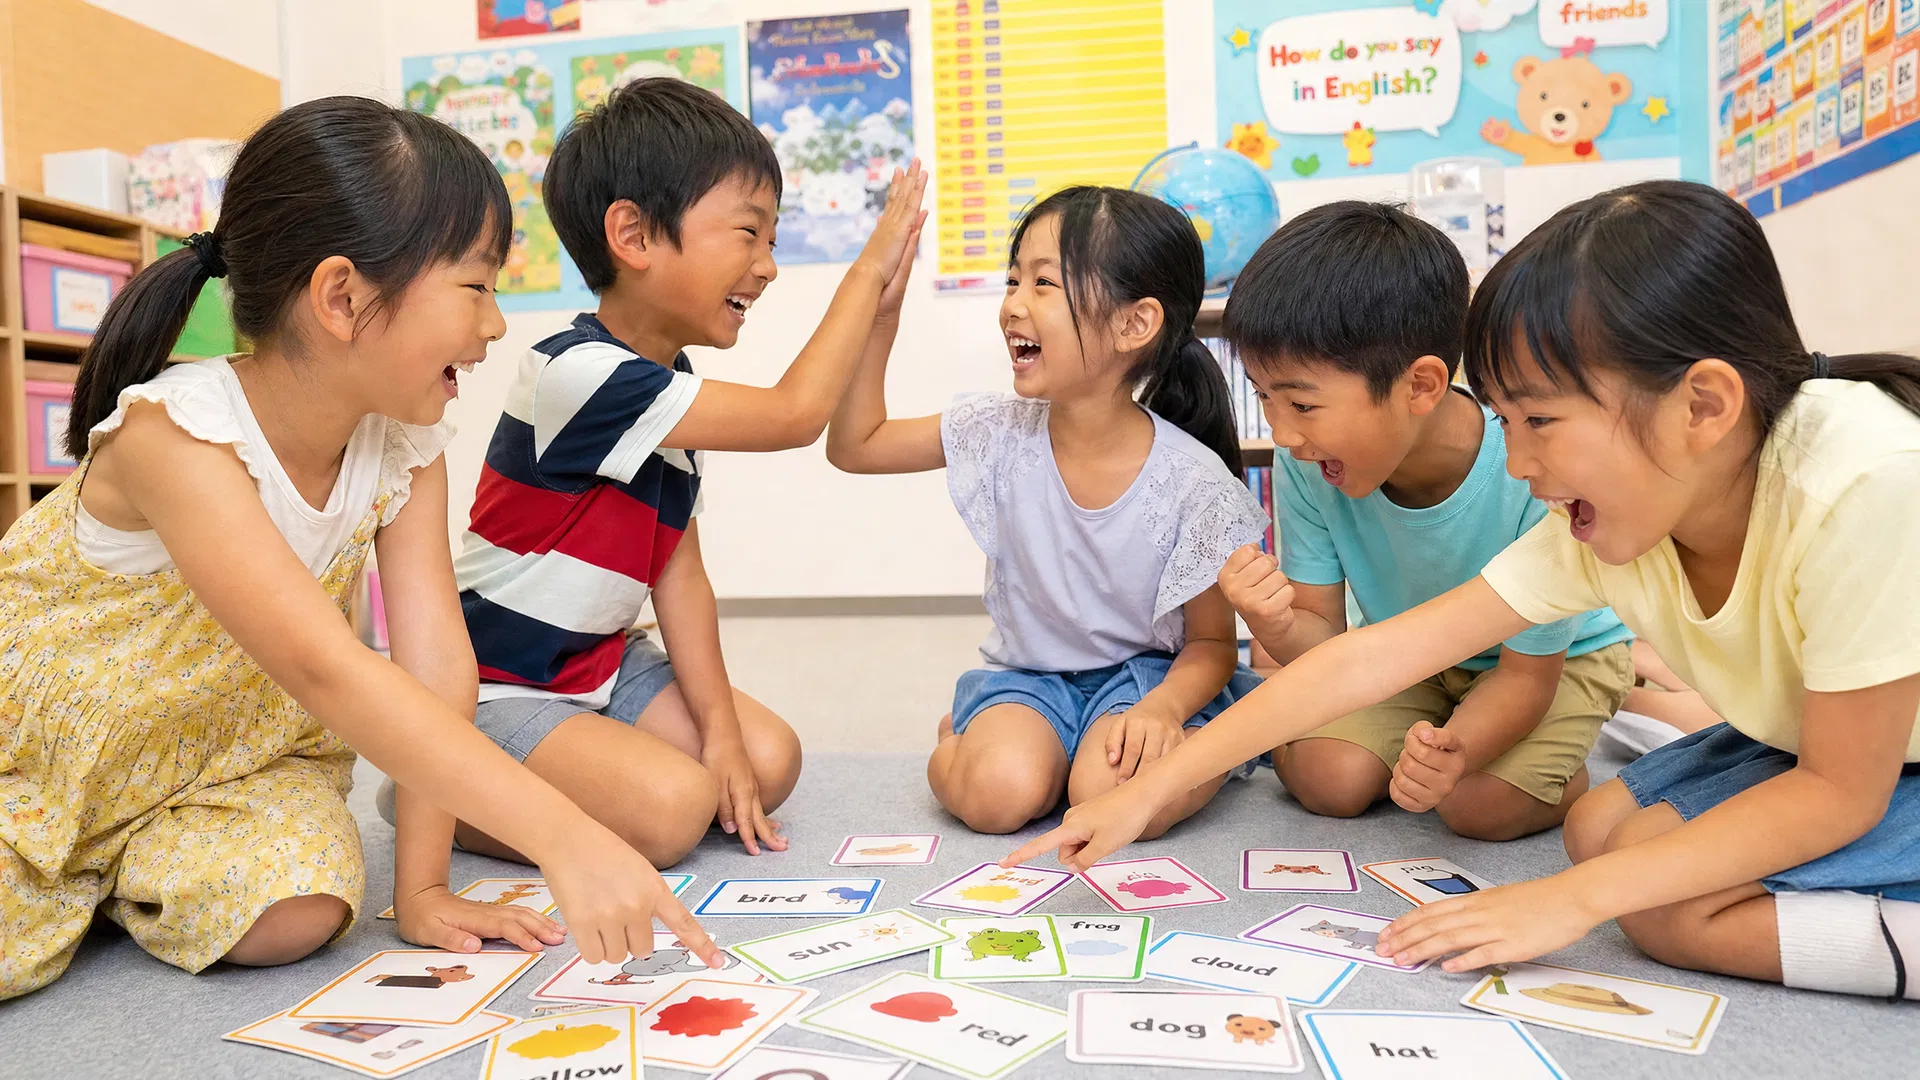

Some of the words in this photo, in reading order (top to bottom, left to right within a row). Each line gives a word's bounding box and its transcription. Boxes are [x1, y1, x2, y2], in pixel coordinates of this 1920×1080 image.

[1559, 0, 1648, 24] friends
[1269, 44, 1321, 67] How
[1329, 39, 1359, 61] do
[1366, 42, 1398, 60] you
[1404, 37, 1442, 57] say
[1293, 80, 1316, 101] in
[1325, 66, 1438, 105] English?
[736, 893, 807, 903] bird
[1070, 920, 1121, 932] frog
[788, 940, 852, 961] sun
[1191, 955, 1278, 977] cloud
[960, 1022, 1028, 1048] red
[1129, 1018, 1207, 1039] dog
[1369, 1041, 1438, 1060] hat
[520, 1064, 624, 1080] llow
